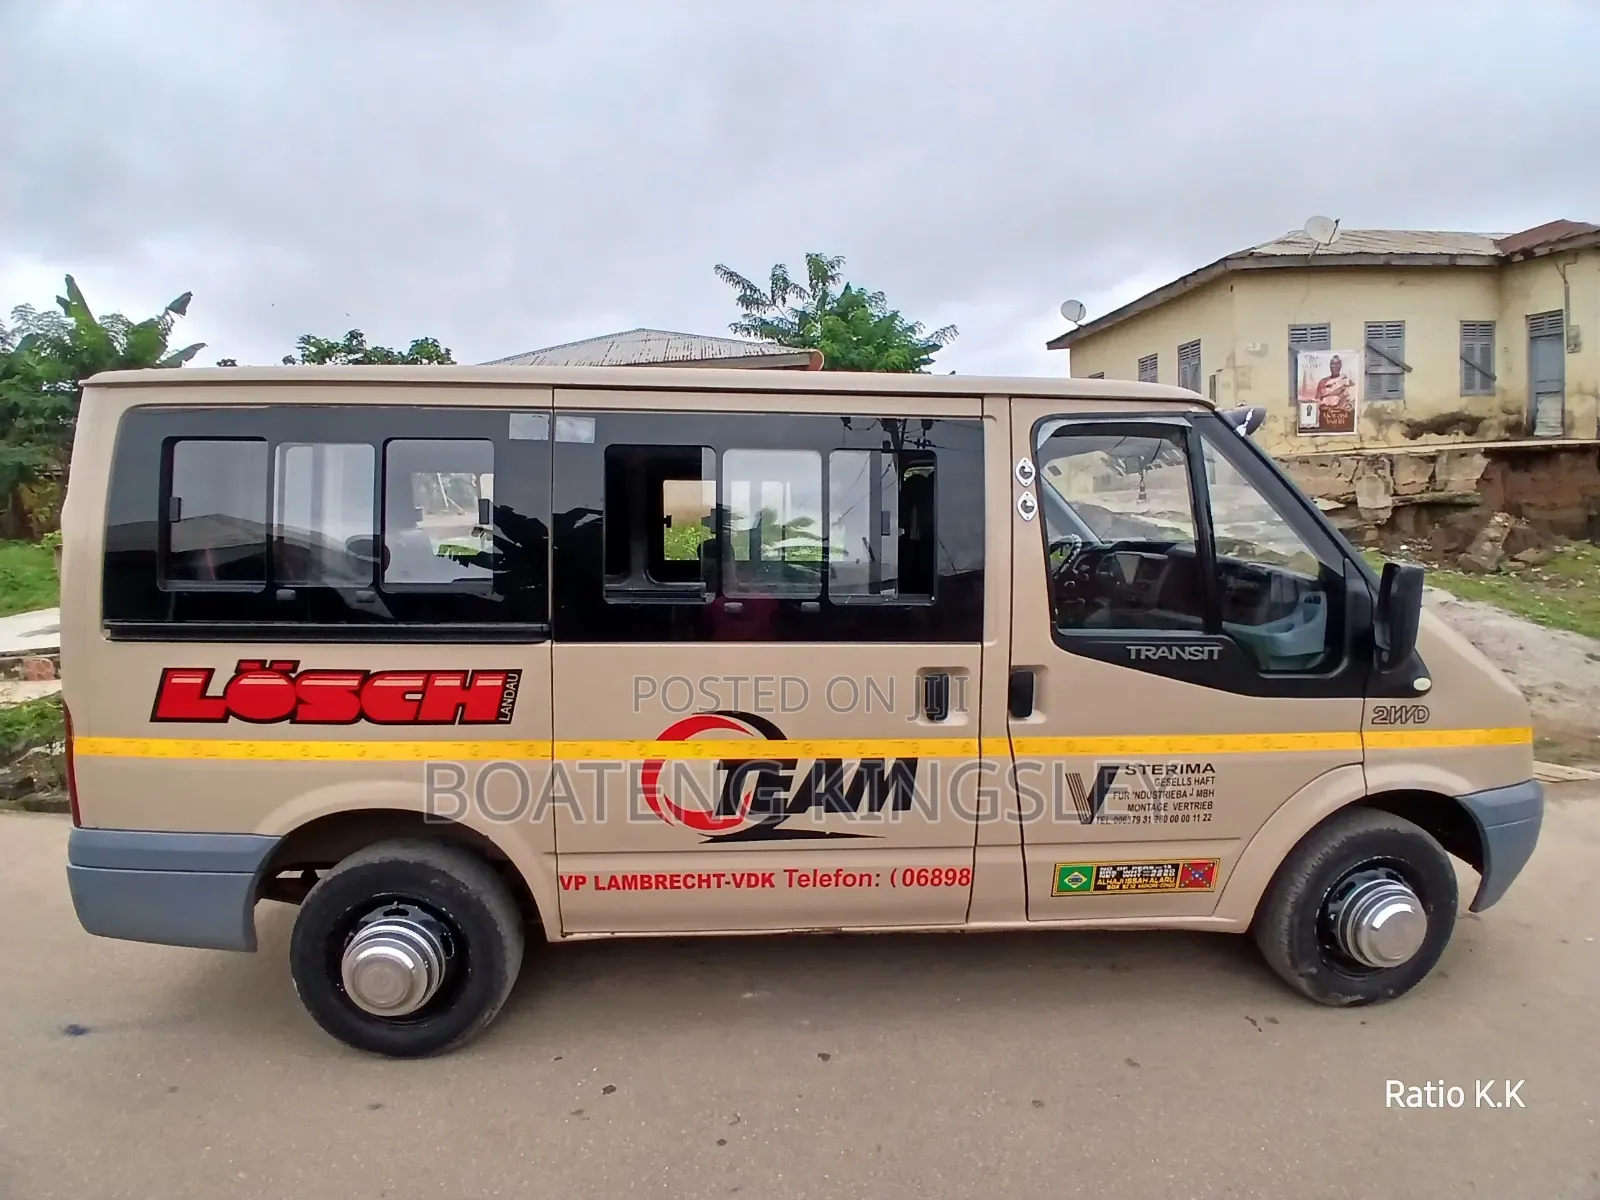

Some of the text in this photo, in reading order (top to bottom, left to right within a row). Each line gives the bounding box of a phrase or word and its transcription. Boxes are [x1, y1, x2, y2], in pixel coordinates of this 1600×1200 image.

[1125, 645, 1223, 660] TRANSIT
[150, 659, 511, 725] LÖSCH
[498, 672, 520, 722] LANDAU
[1371, 704, 1430, 725] 2WD
[1124, 762, 1216, 776] STERIMA
[711, 756, 919, 817] TEAM
[1127, 800, 1214, 813] MONTAGE VERTRIEB
[1192, 813, 1201, 822] 11
[1202, 812, 1213, 822] 22
[559, 874, 587, 891] VP
[594, 872, 776, 891] LAMBRECHT-VDK
[783, 868, 880, 888] Telefon:
